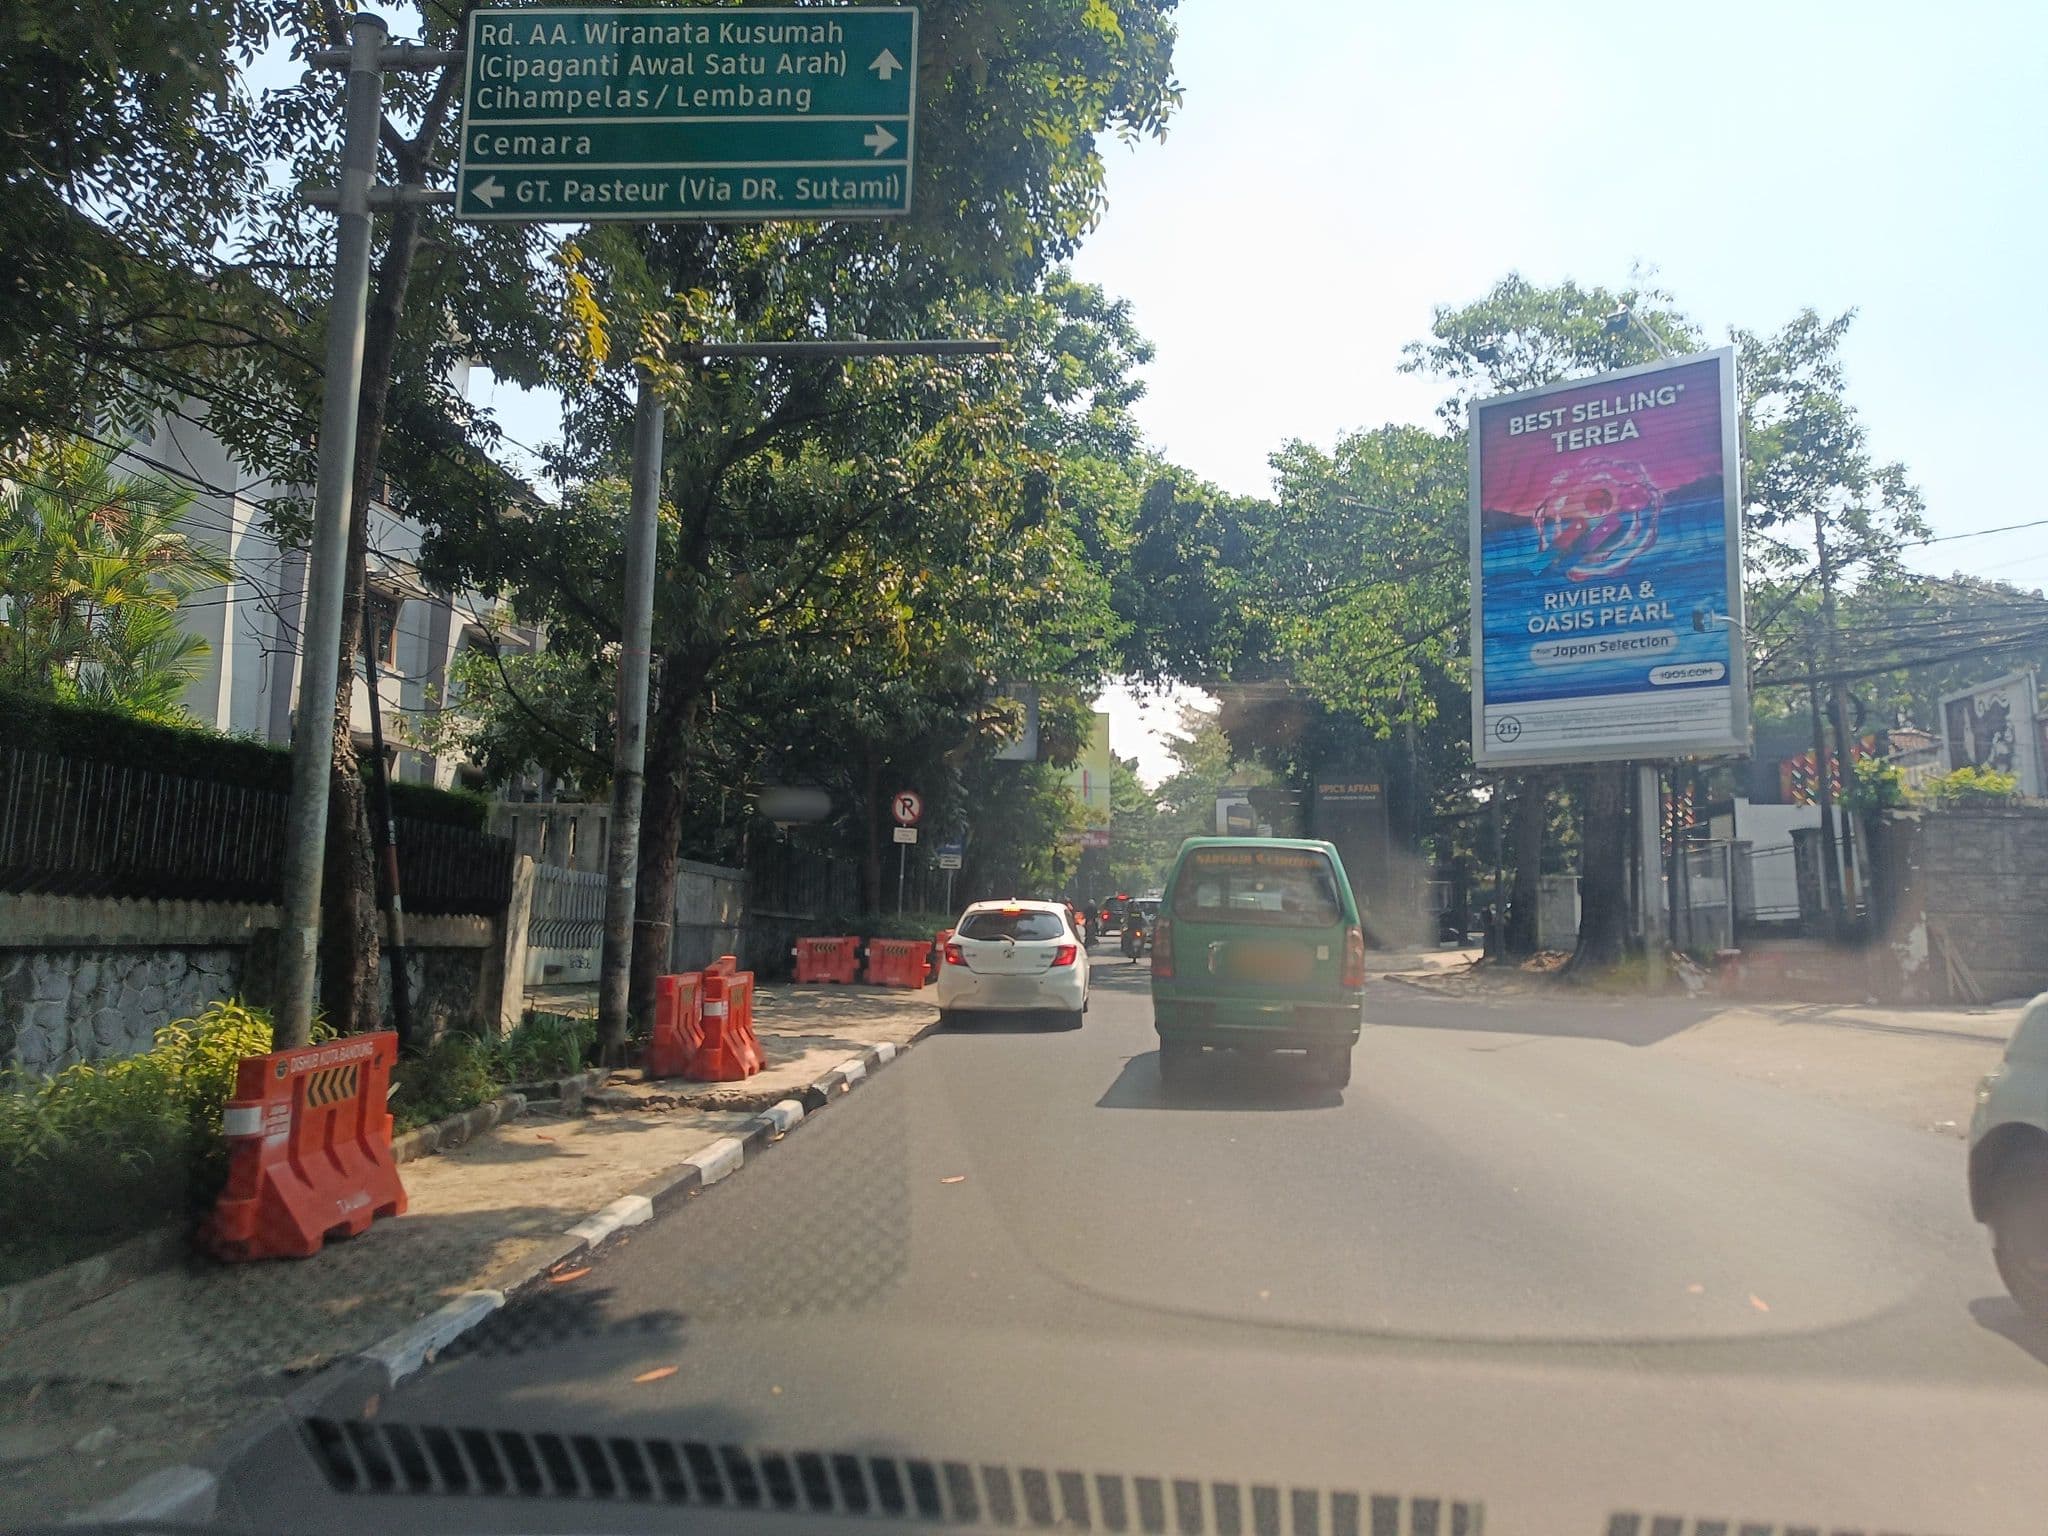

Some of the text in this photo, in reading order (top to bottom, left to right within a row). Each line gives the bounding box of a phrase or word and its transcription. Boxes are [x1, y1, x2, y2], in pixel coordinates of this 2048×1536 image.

[481, 21, 844, 46] Rd. AA. Wiranata Kusumah
[479, 50, 848, 83] (Cipaganti Awal Satu Arah)
[473, 133, 592, 157] Cemara
[516, 174, 900, 205] GT. Pasteur (Via DR. Sutami)
[1510, 407, 1567, 436] BEST
[1551, 418, 1640, 453] TEREA
[1543, 580, 1656, 611] RIVIERA &
[1527, 600, 1676, 634] OASIS PEARL
[1552, 644, 1596, 659] Japan
[1599, 635, 1669, 653] Selection
